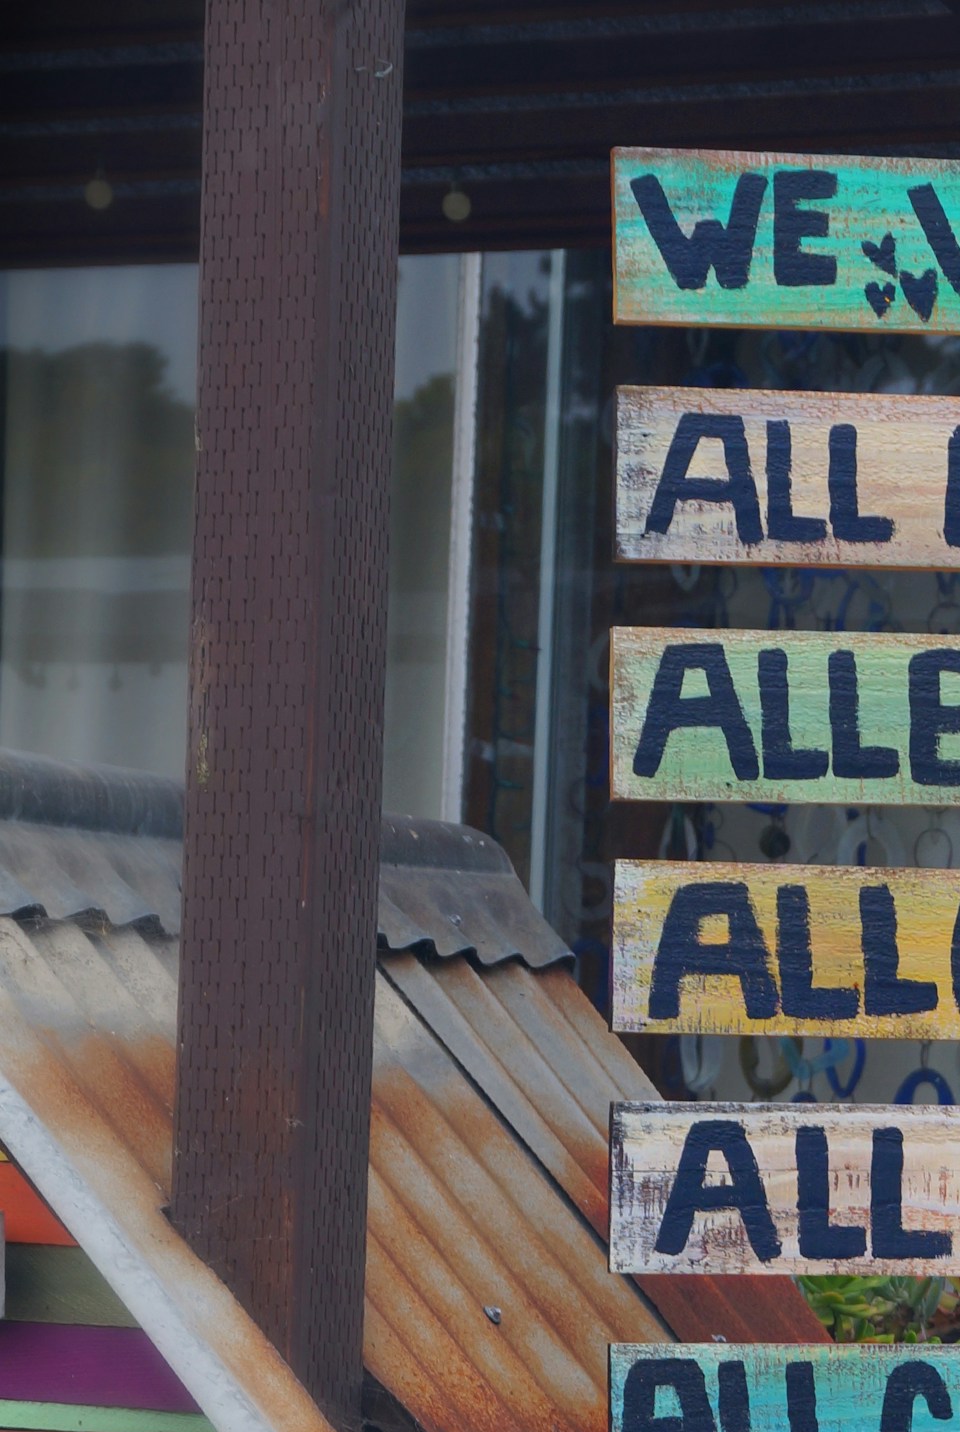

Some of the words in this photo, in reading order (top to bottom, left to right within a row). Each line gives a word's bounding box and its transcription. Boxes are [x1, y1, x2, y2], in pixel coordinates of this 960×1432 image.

[630, 169, 838, 289] WE
[644, 412, 895, 545] ALL
[632, 643, 899, 780] ALL
[647, 882, 938, 1021] ALL
[654, 1119, 953, 1263] ALL
